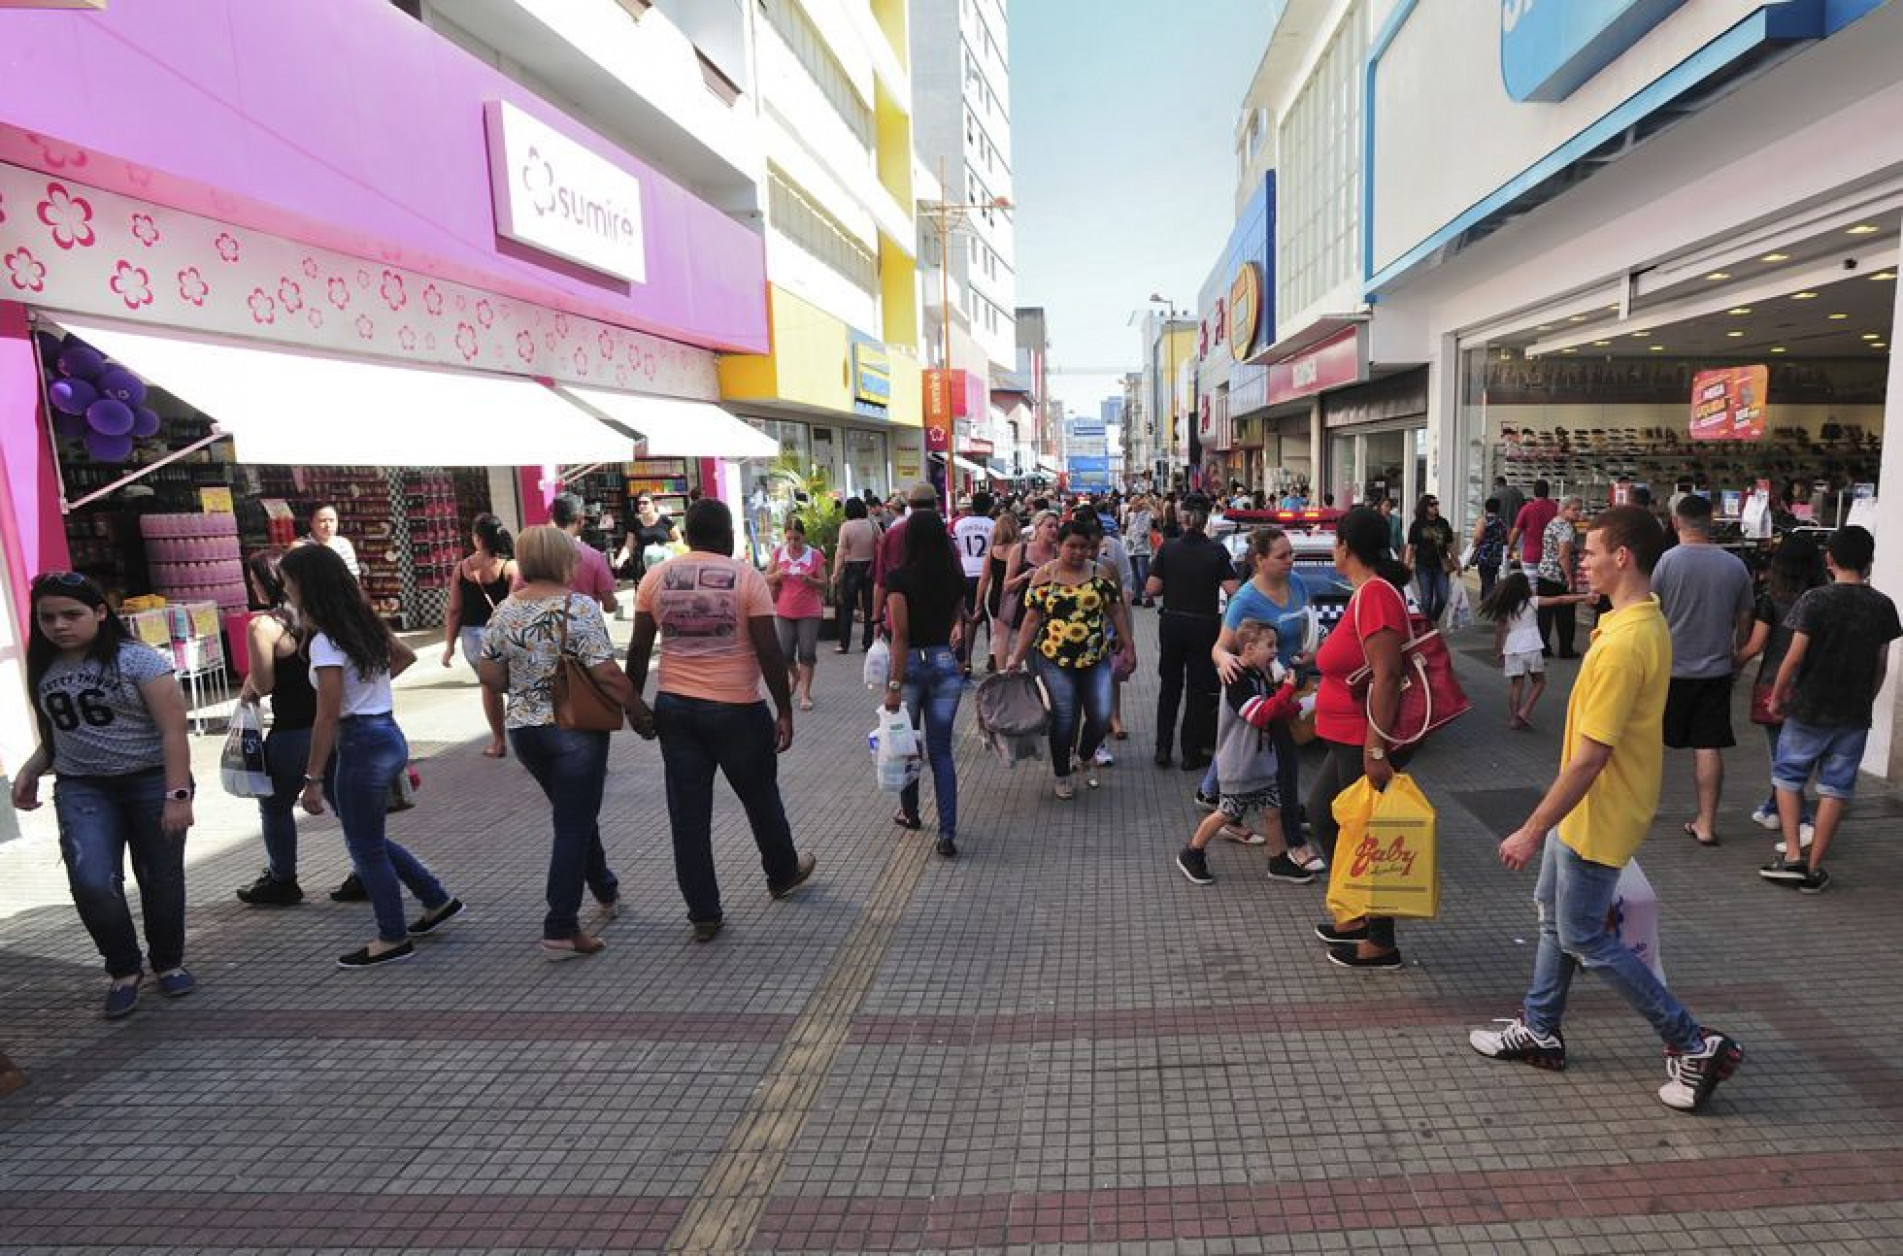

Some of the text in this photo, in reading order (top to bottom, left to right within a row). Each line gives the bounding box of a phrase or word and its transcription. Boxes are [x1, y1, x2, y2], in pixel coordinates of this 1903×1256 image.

[966, 534, 988, 557] 12
[46, 689, 115, 731] 86
[1349, 833, 1417, 878] Baby
